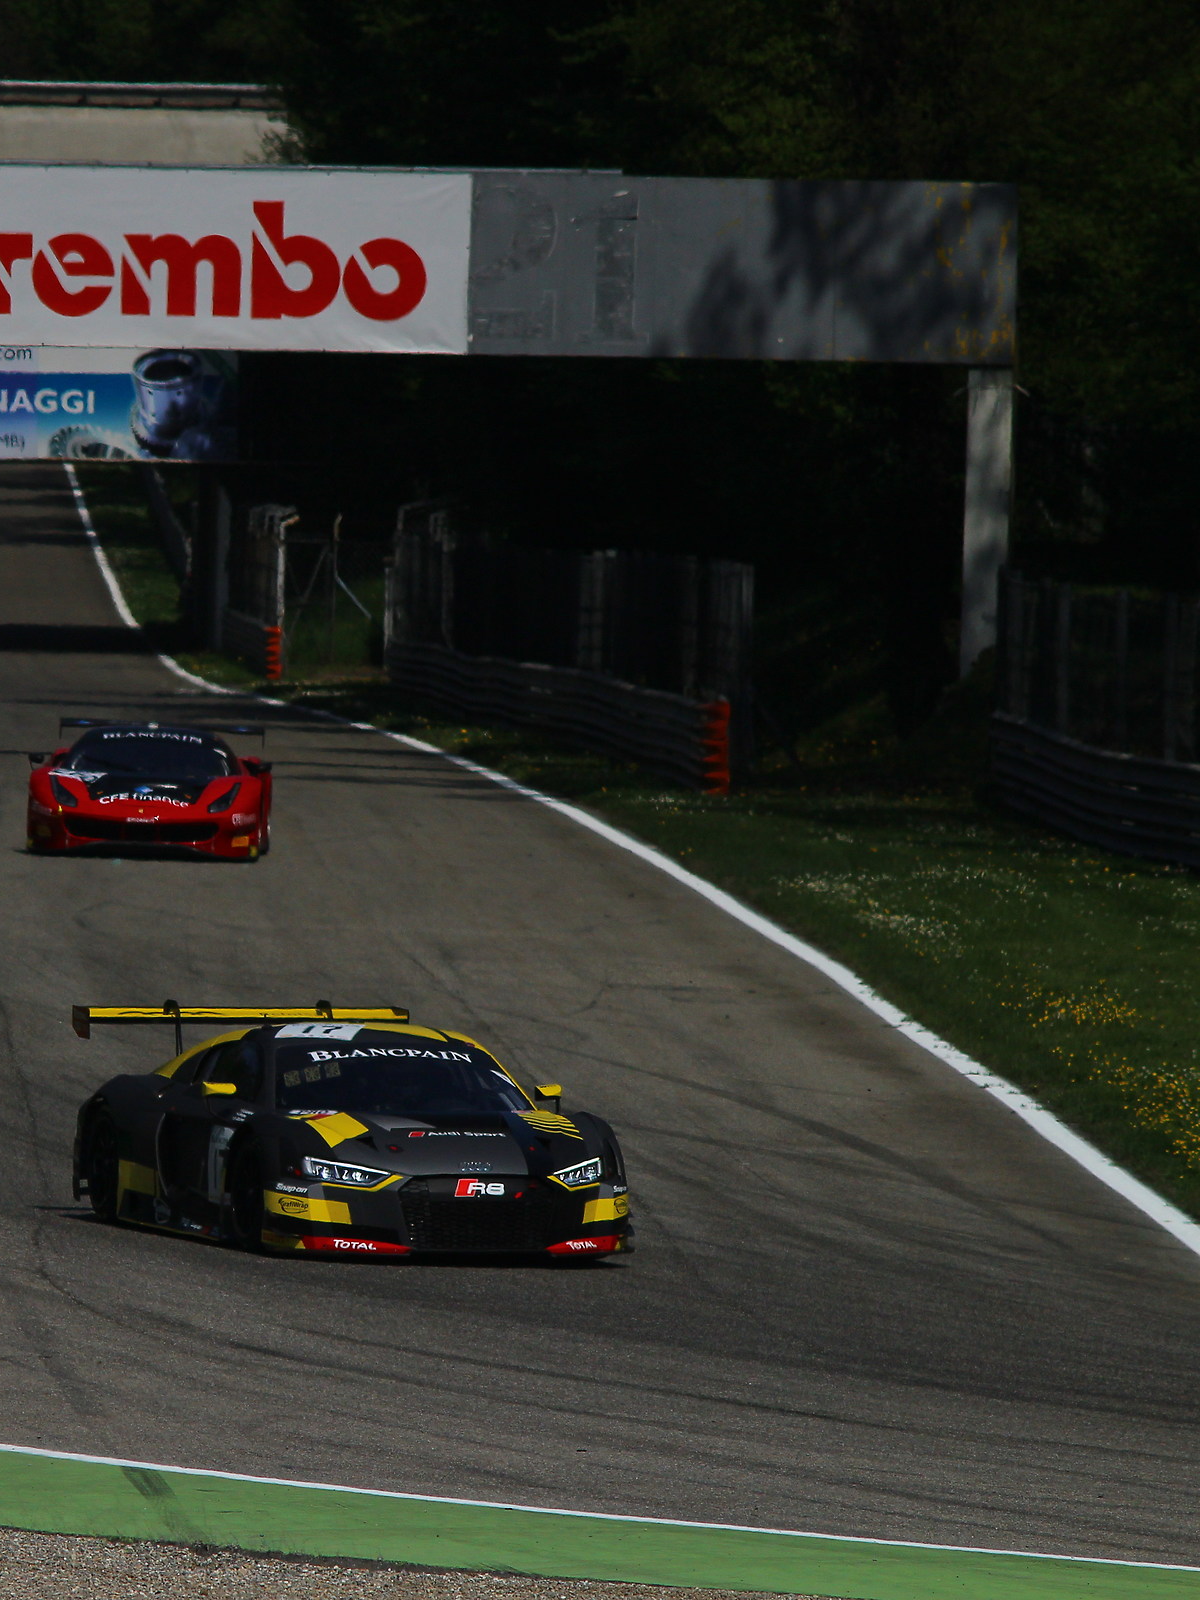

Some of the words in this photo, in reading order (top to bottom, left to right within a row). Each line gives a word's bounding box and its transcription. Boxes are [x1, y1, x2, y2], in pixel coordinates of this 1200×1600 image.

[99, 792, 130, 805] CFE
[307, 1048, 473, 1064] BLANCPAIN
[275, 1182, 309, 1194] Snap-on
[466, 1182, 506, 1196] R8
[333, 1238, 377, 1251] TOTAL
[566, 1240, 598, 1251] TOTAL
